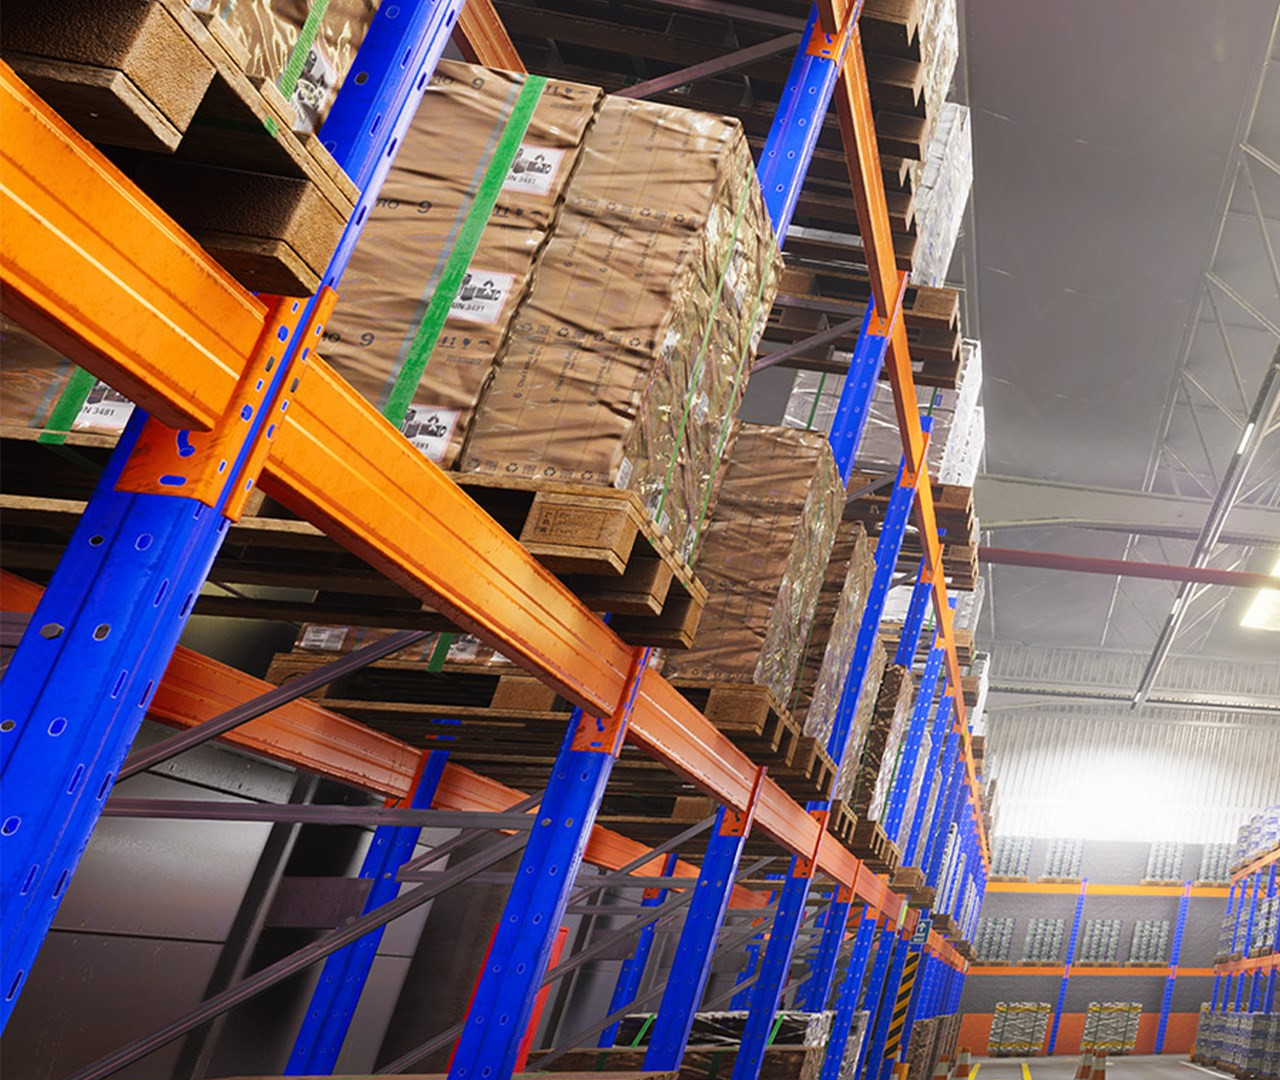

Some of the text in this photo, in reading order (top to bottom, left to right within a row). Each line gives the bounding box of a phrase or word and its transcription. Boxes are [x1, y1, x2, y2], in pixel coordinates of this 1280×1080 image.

[416, 200, 433, 215] 9
[358, 331, 375, 347] 9
[92, 406, 116, 417] 3481
